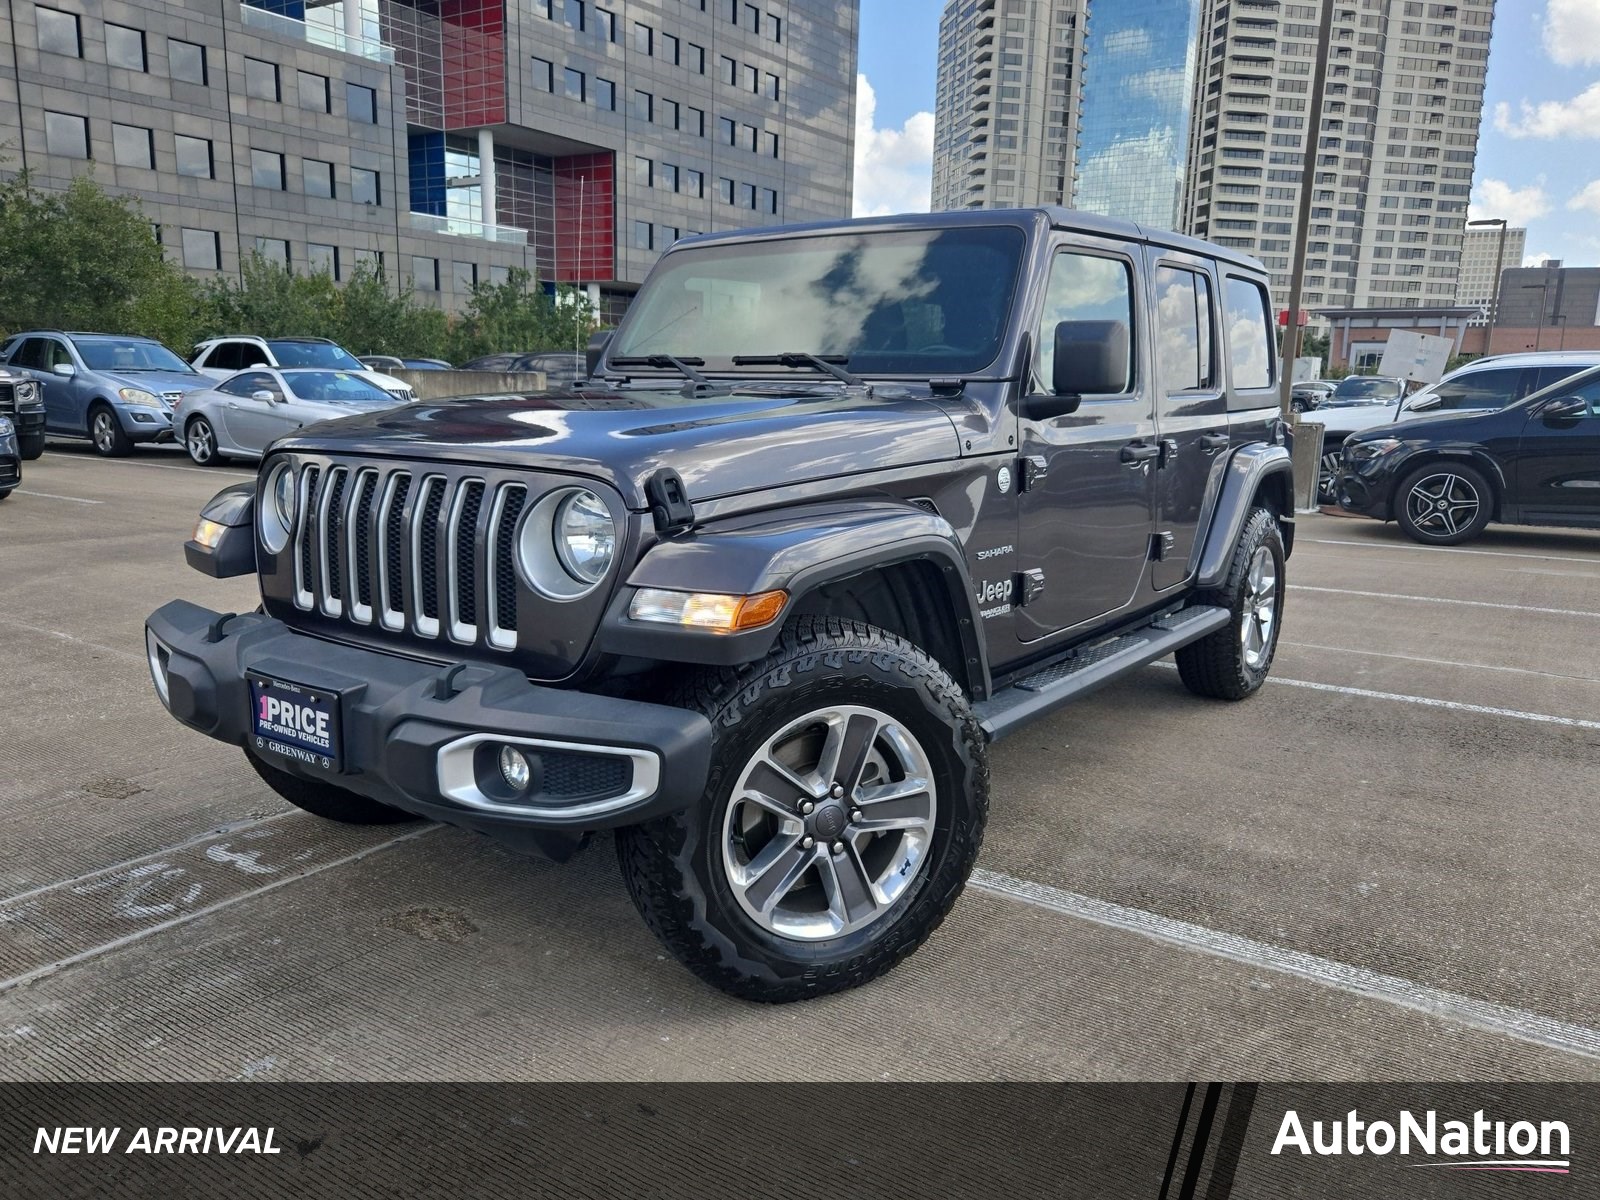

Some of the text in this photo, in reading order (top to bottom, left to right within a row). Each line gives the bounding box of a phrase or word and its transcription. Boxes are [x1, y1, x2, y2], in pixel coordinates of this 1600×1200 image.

[977, 545, 1013, 560] SAHARA
[976, 580, 1012, 604] Jeep
[259, 719, 330, 748] PRE-OWNED VEHICLES
[268, 741, 316, 764] GREENWAY
